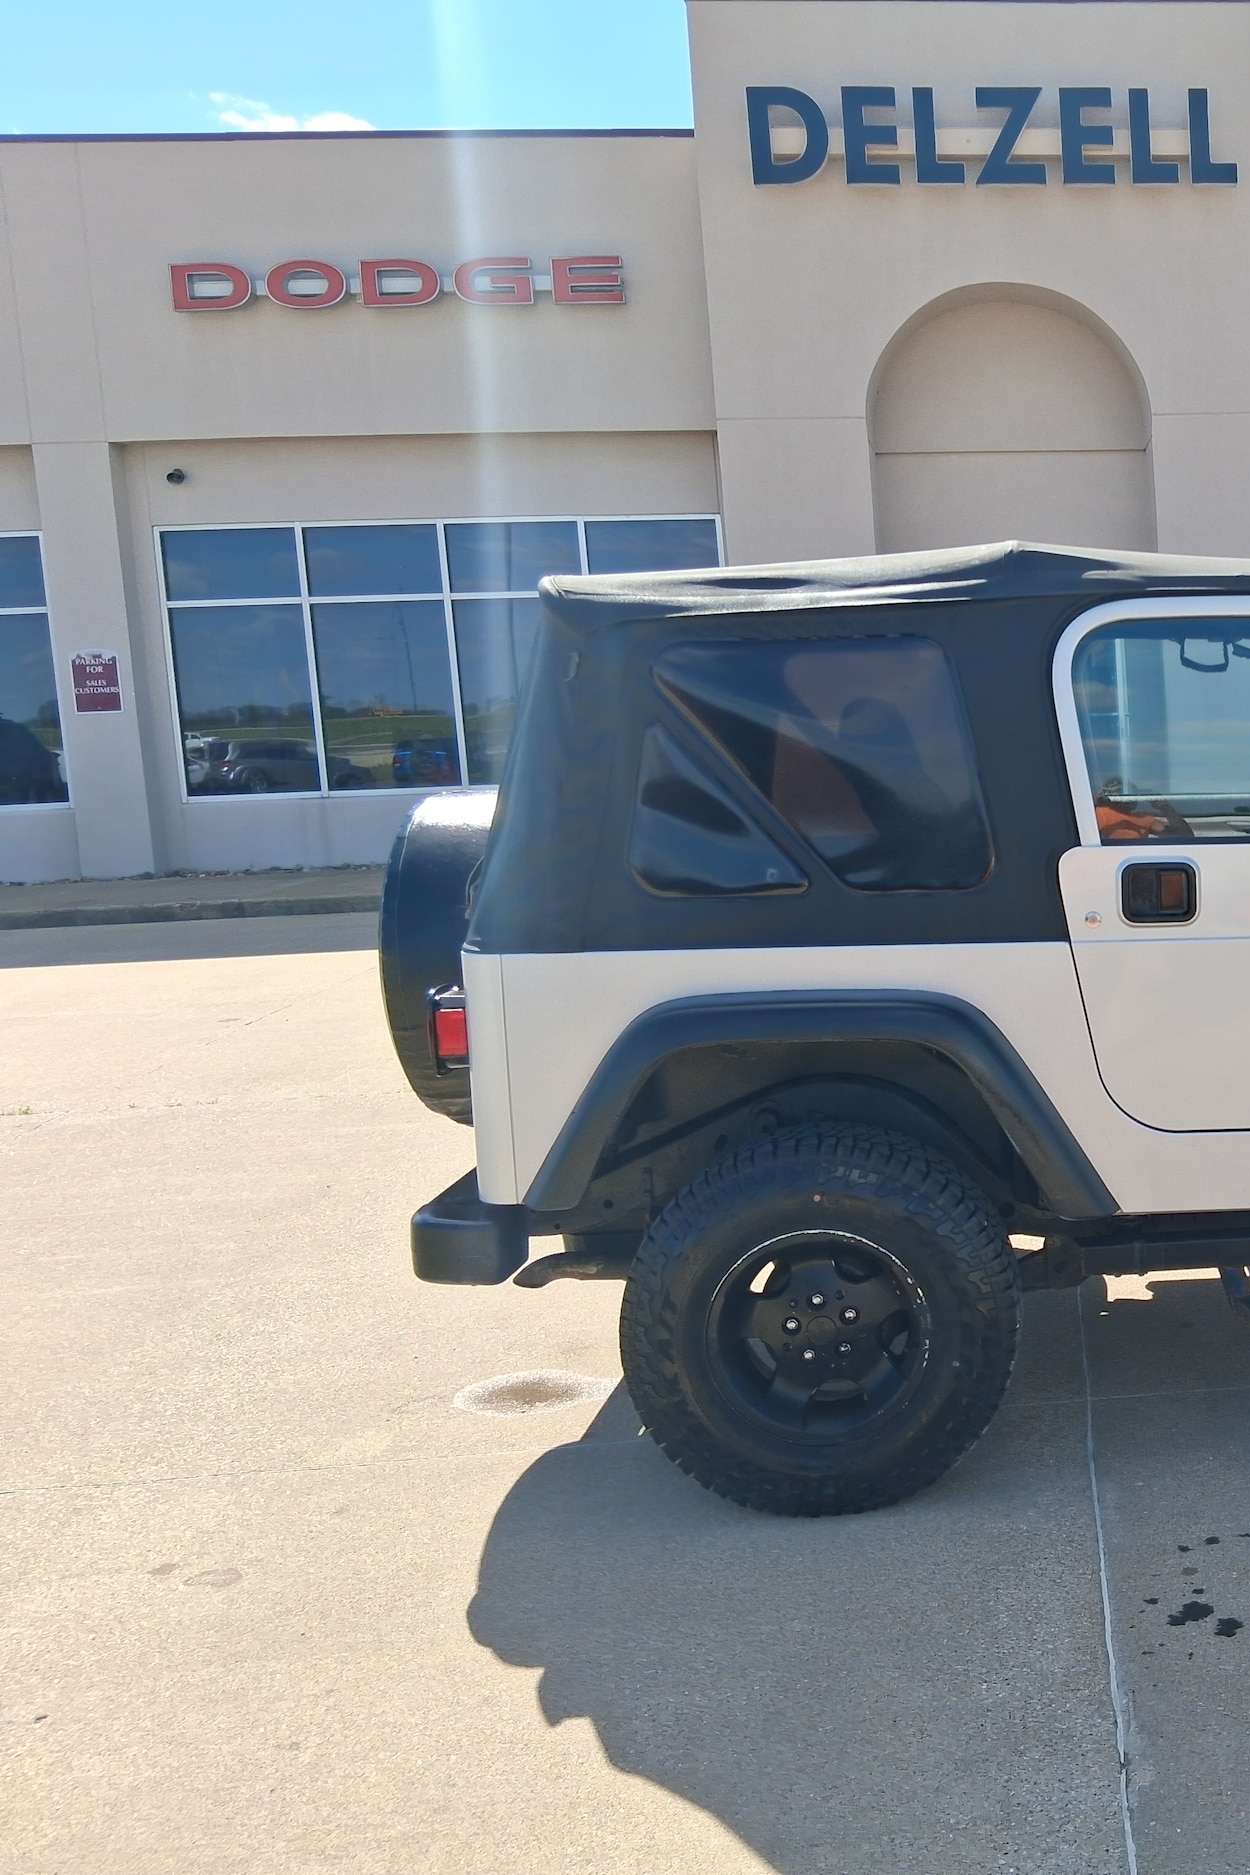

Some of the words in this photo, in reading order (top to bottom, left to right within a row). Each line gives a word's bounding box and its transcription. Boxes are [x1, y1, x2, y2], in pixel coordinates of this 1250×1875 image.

[745, 86, 1238, 185] DELZELL
[168, 256, 626, 312] DODGE
[75, 657, 112, 665] PARKING
[86, 665, 104, 673] FOR
[75, 686, 119, 694] CUSTOMERS
